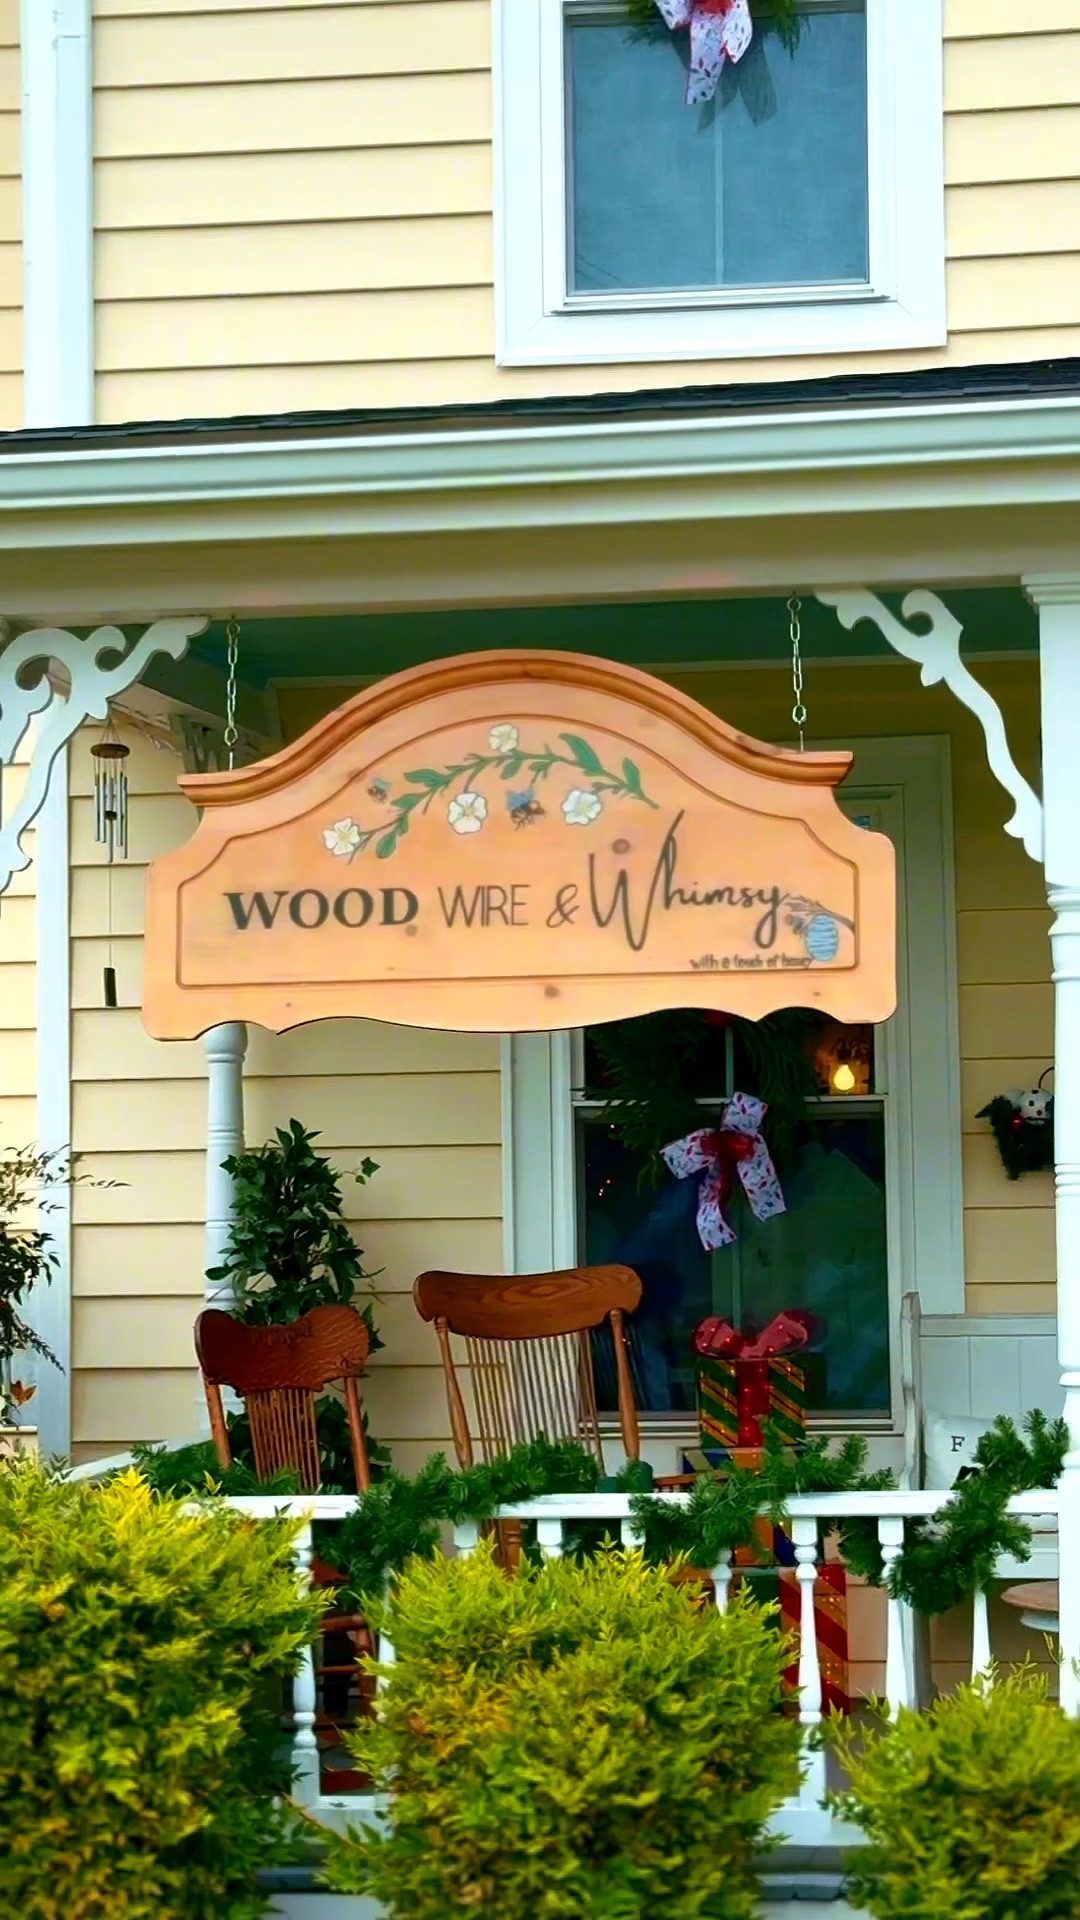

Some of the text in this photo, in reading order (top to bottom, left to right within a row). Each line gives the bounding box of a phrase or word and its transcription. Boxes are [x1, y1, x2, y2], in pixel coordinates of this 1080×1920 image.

[223, 809, 791, 952] WOOD WIRE & Whimsy
[689, 953, 719, 969] with
[721, 957, 730, 969] a
[733, 953, 763, 969] touch
[767, 954, 780, 968] of
[951, 1435, 965, 1452] F
